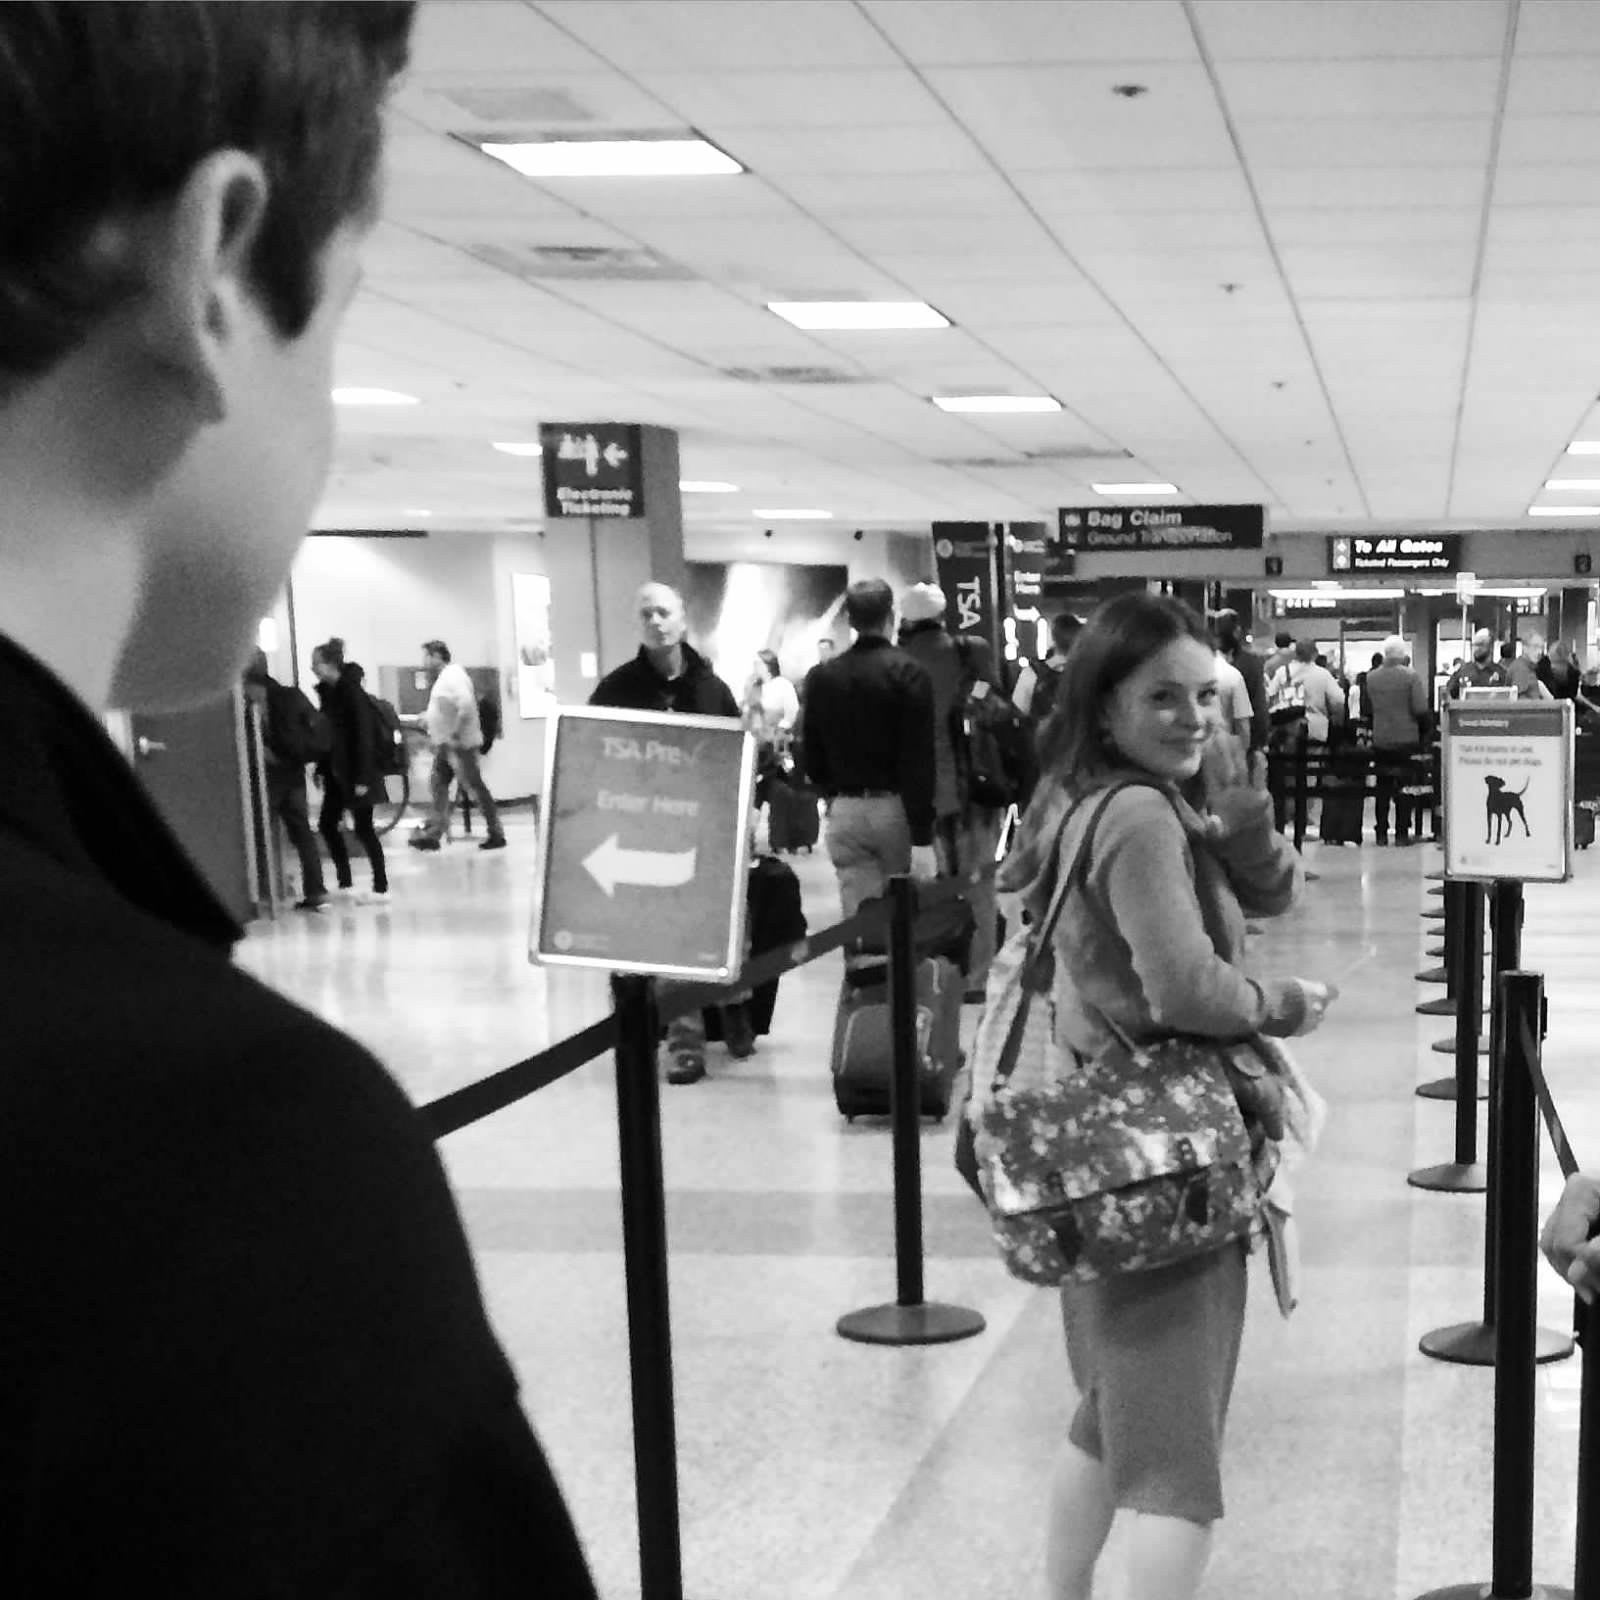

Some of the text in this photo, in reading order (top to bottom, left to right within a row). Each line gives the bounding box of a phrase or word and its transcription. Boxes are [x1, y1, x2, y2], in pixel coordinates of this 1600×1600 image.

[1087, 508, 1182, 530] Bag Claim
[1087, 530, 1136, 545] Ground
[1354, 538, 1443, 553] To All Gates
[956, 576, 981, 629] TSA
[602, 737, 642, 760] TSA
[597, 790, 700, 817] Enter Here
